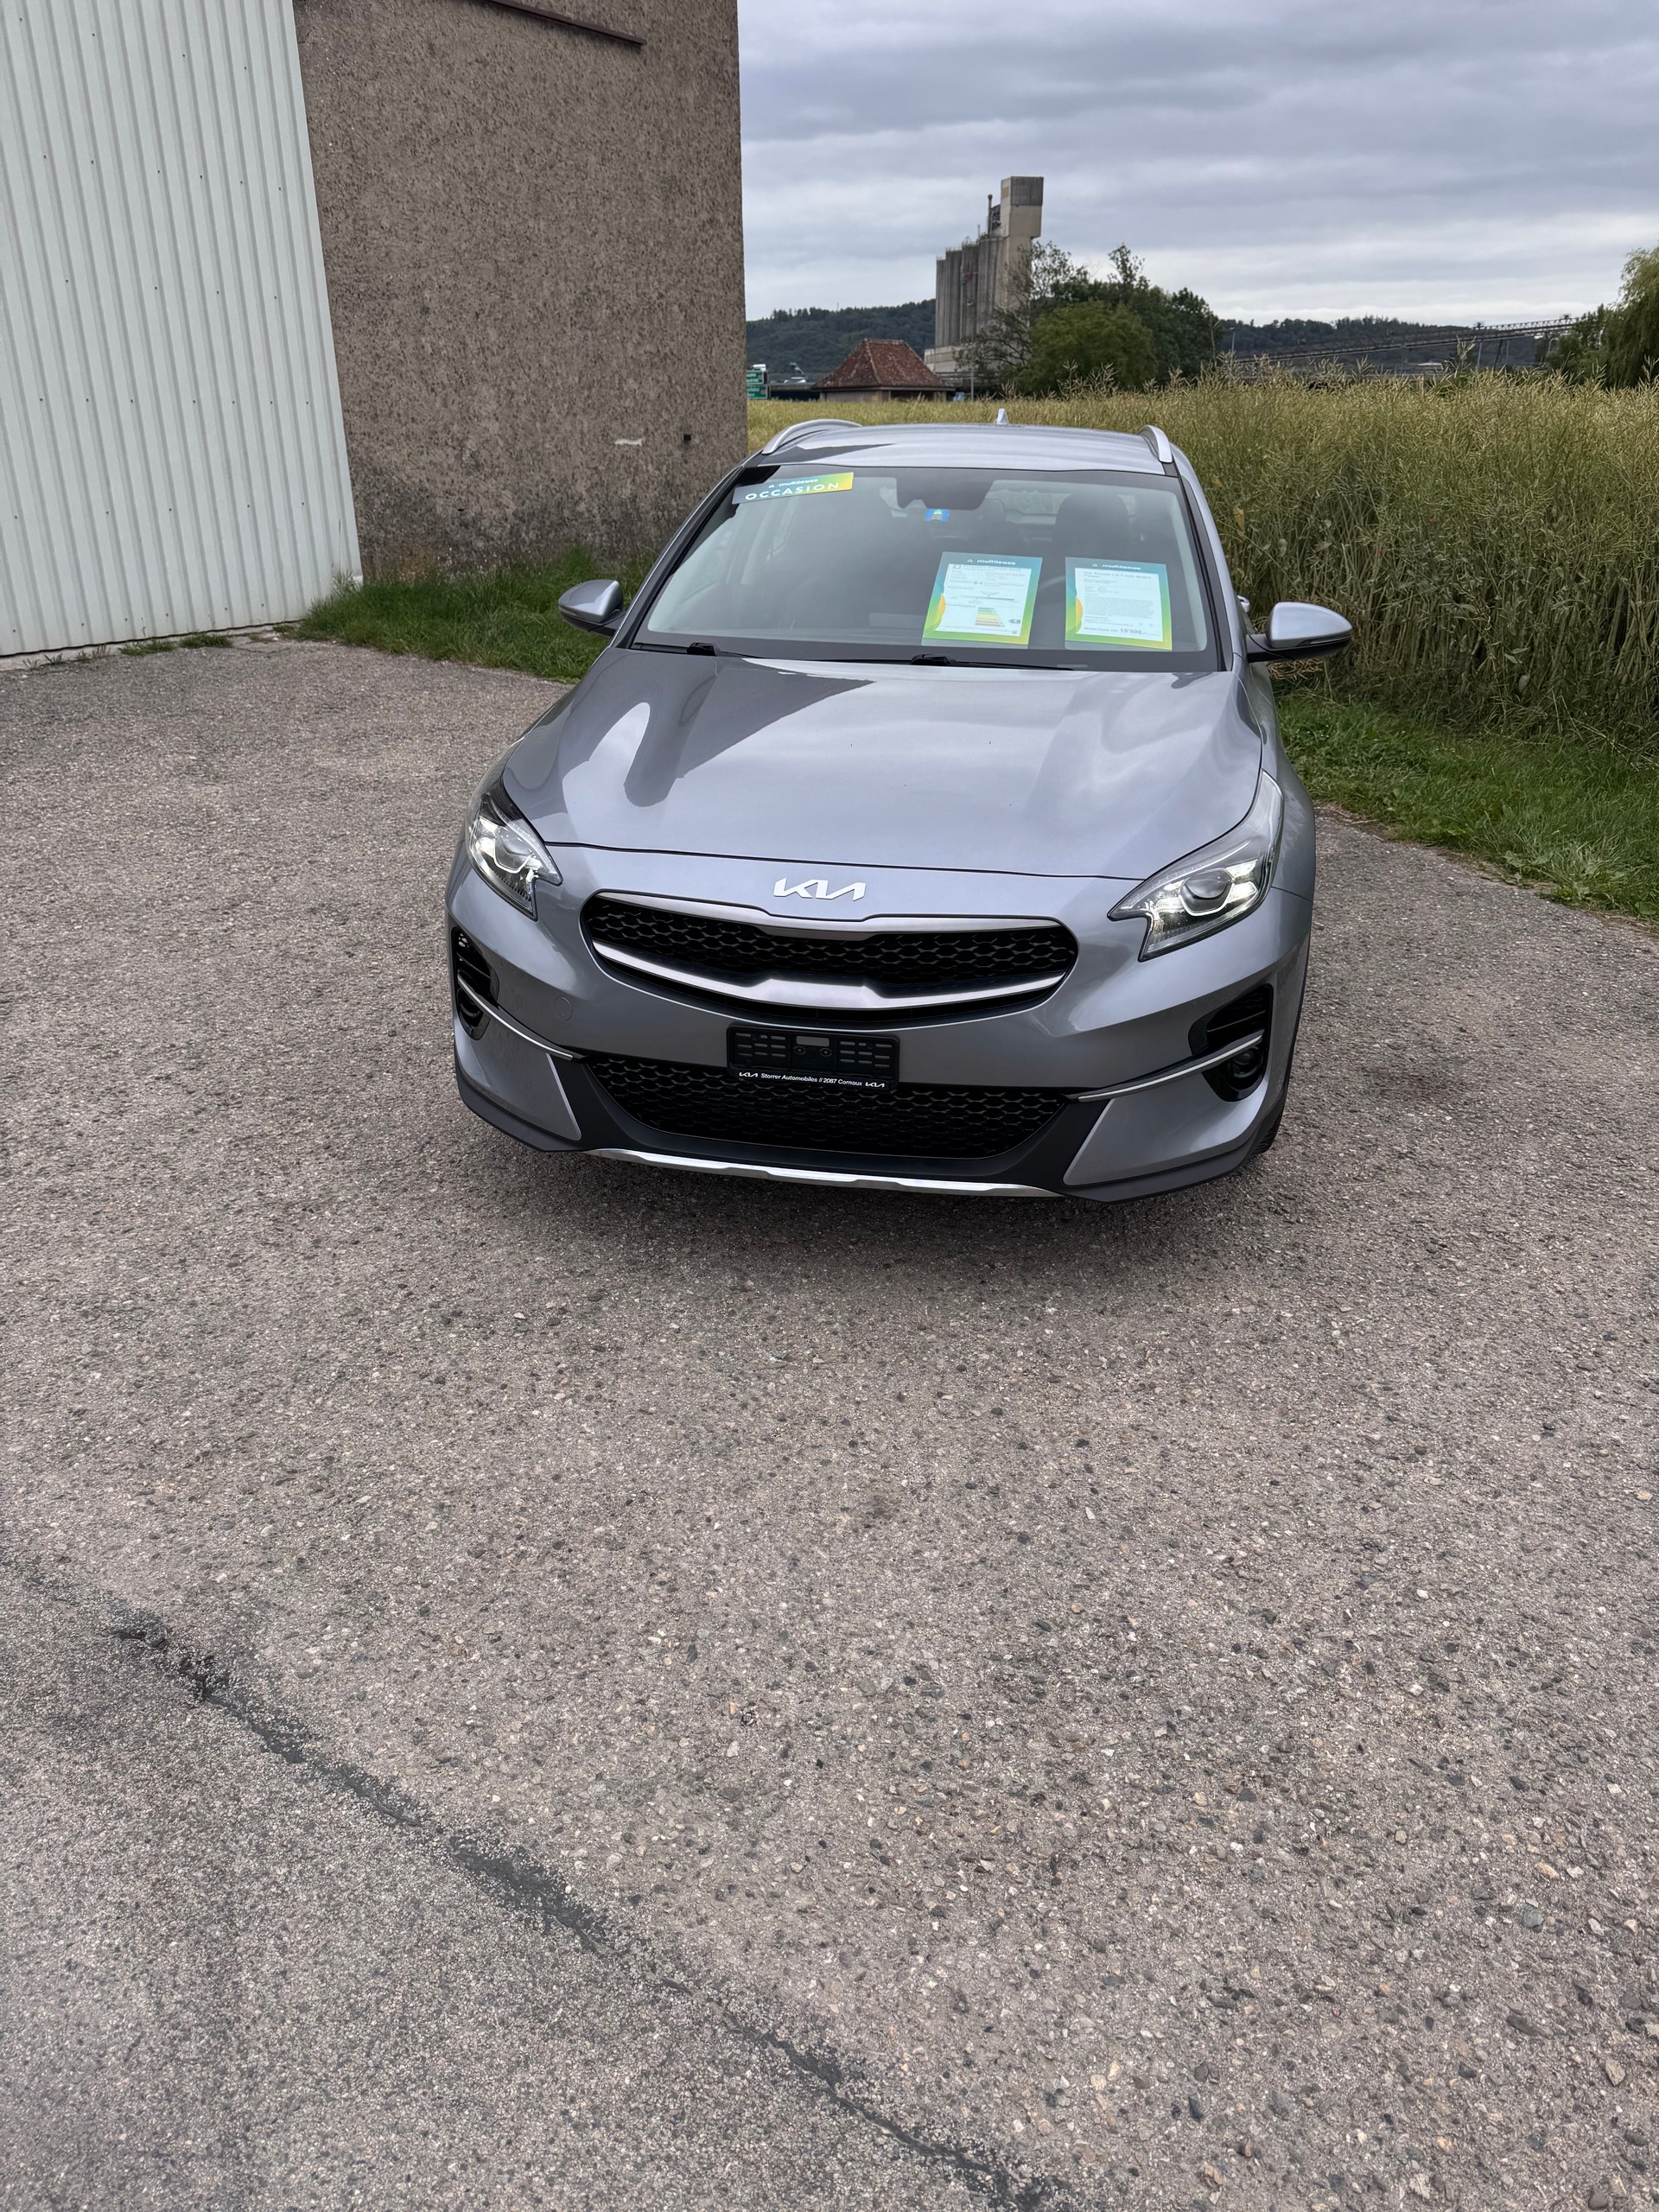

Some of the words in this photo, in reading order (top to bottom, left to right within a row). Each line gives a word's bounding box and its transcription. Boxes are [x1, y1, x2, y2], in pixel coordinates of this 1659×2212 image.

[745, 482, 839, 500] OCCASION
[773, 877, 867, 902] KIA
[781, 1074, 818, 1083] Automobiles
[837, 1078, 862, 1087] Cornaux
